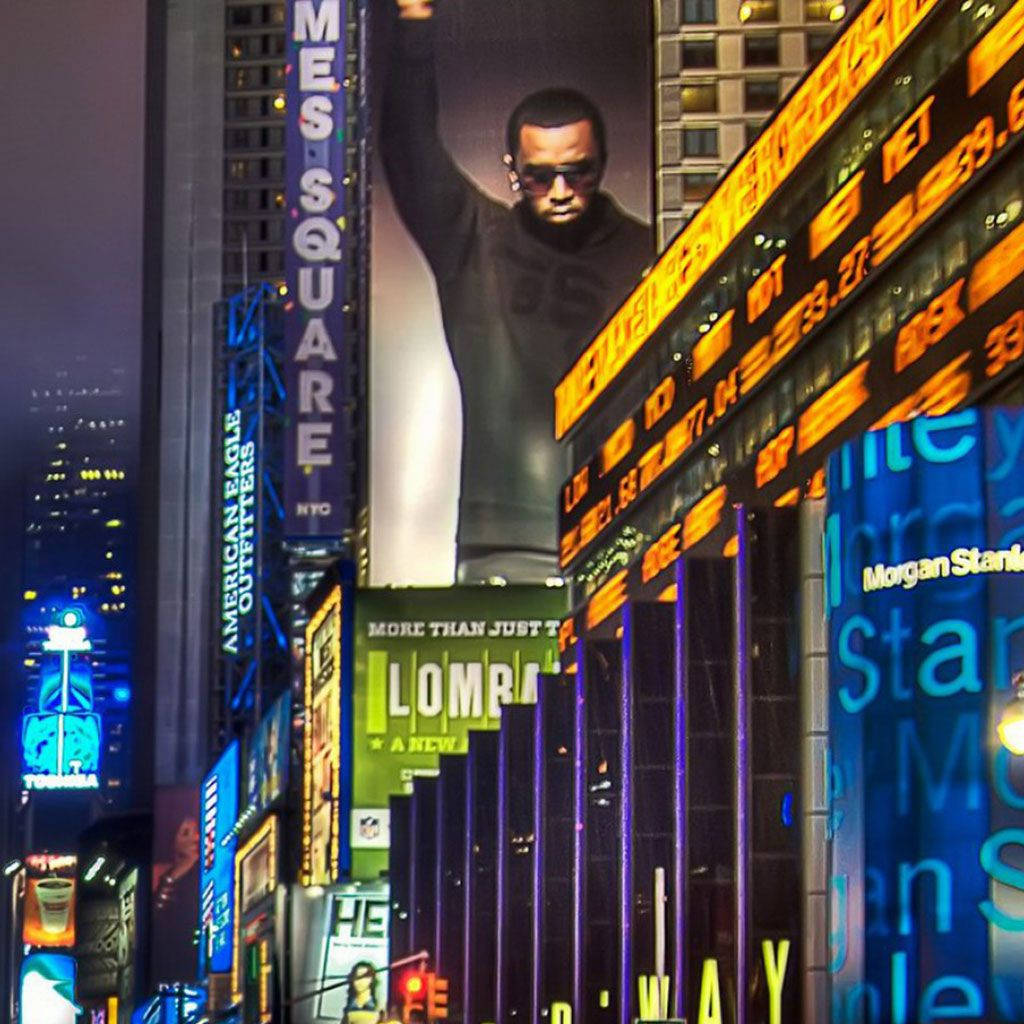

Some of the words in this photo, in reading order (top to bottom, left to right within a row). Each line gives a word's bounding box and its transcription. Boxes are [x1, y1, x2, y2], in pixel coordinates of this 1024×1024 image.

[292, 169, 342, 468] SQUARE
[224, 409, 241, 498] EAGLE
[238, 440, 255, 615] OUTFITTERS
[296, 502, 331, 516] NYC
[223, 502, 240, 655] AMERICAN
[862, 556, 951, 593] Morgan
[368, 621, 426, 638] MORE
[429, 621, 487, 638] THAN
[488, 620, 542, 637] JUST
[390, 737, 406, 753] A
[407, 736, 457, 753] NEW
